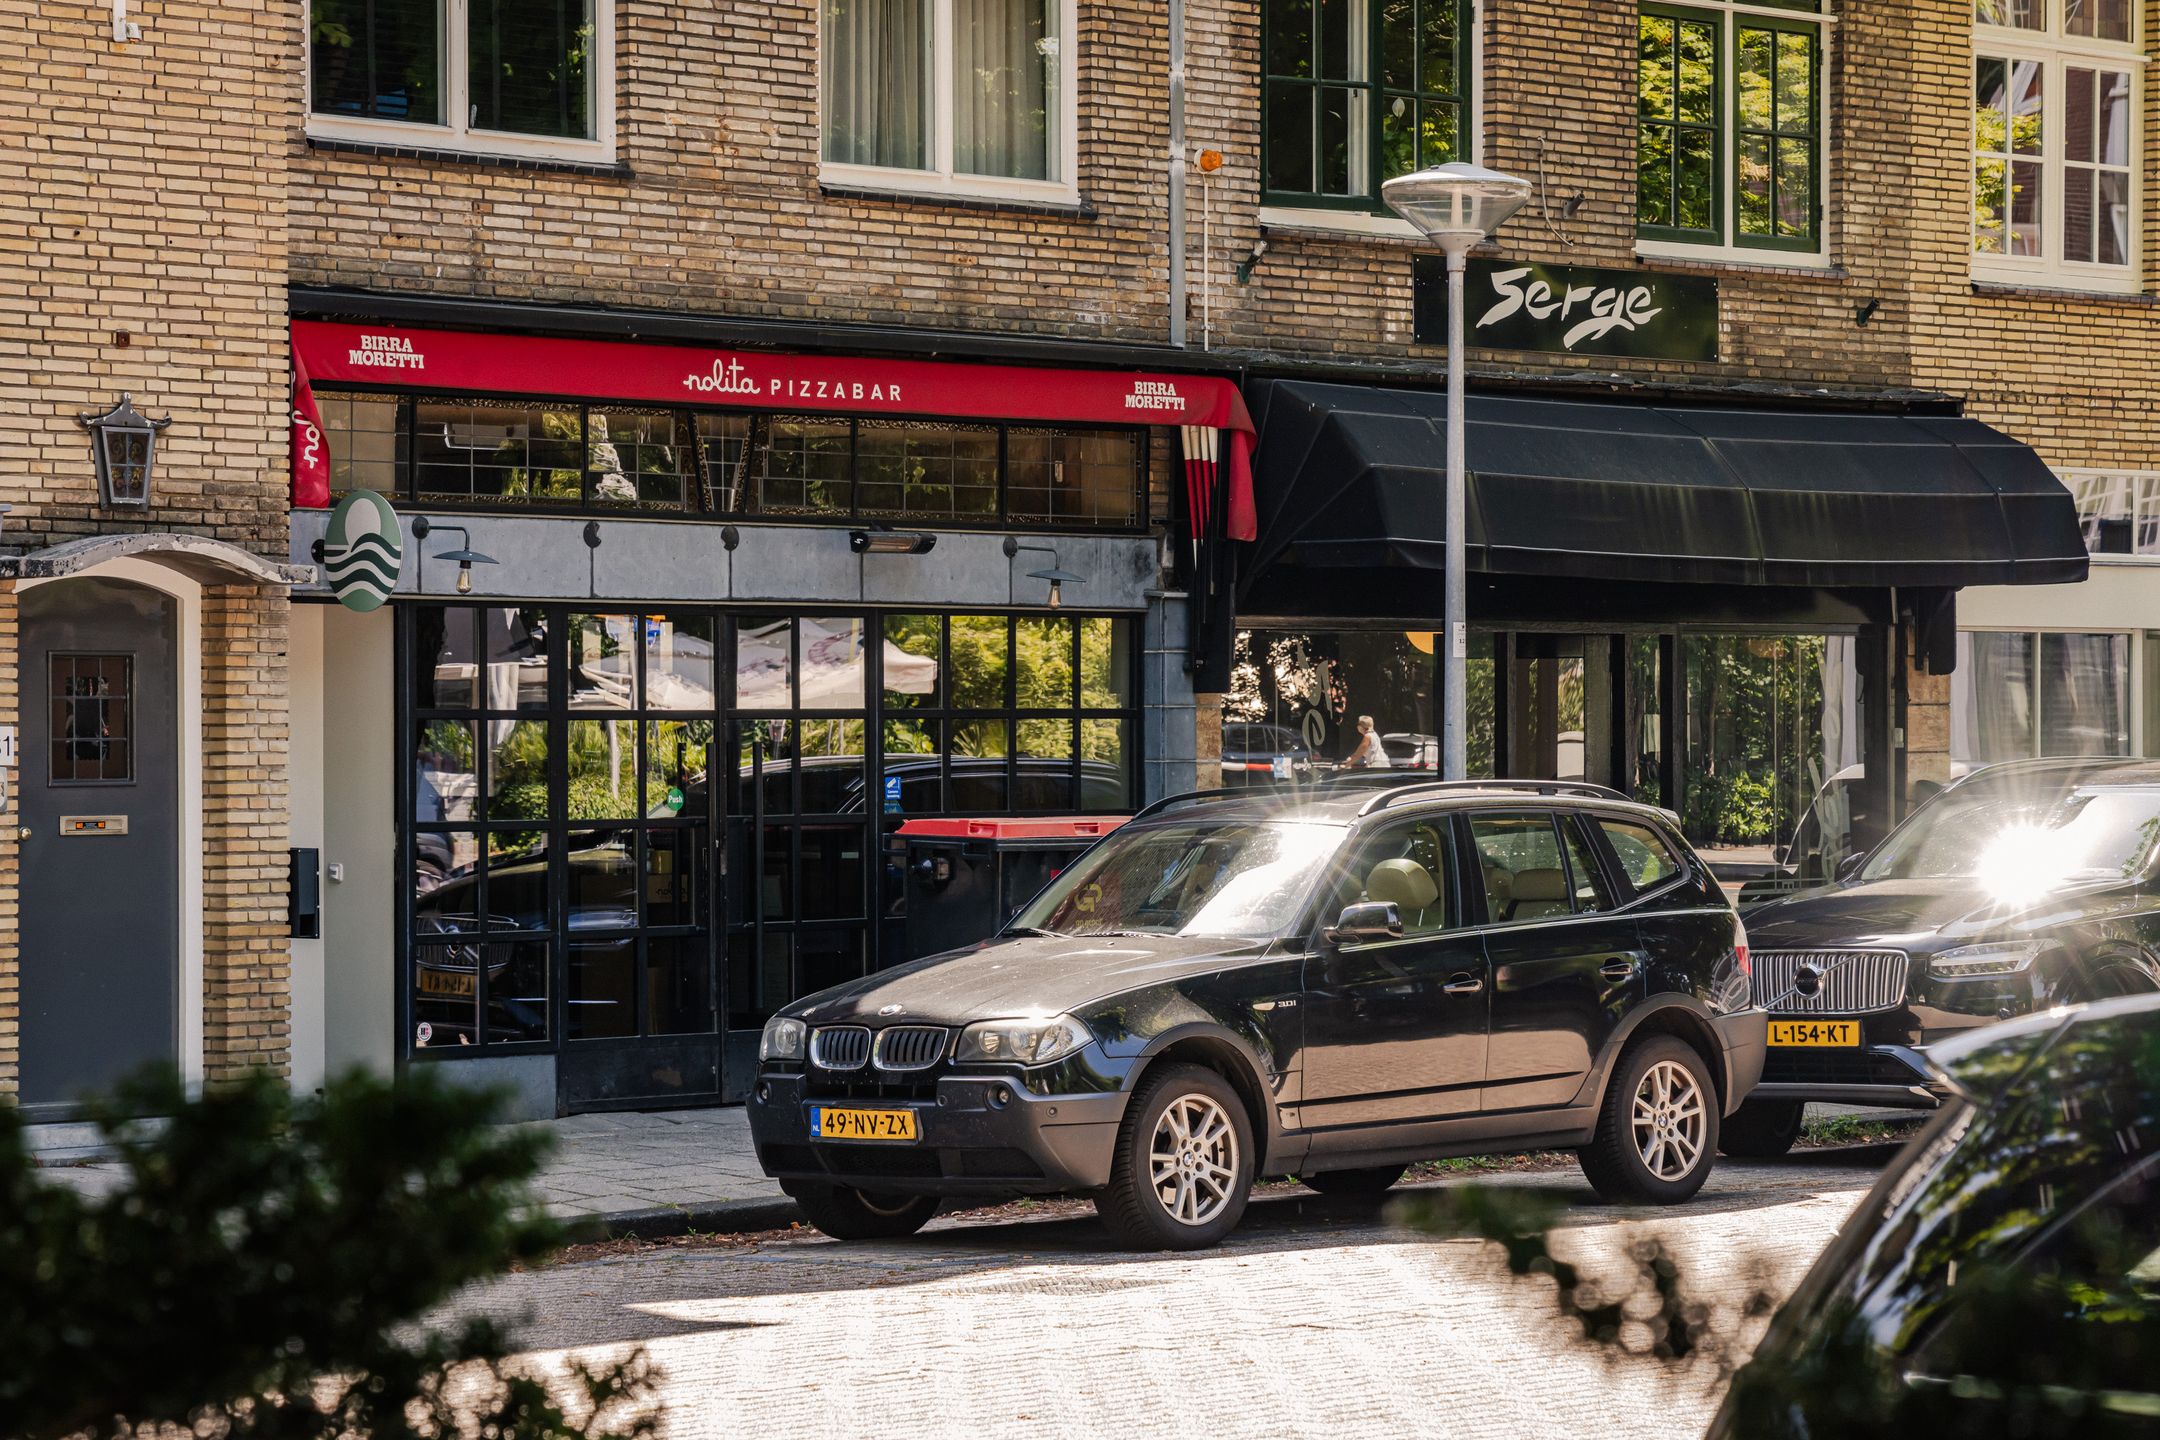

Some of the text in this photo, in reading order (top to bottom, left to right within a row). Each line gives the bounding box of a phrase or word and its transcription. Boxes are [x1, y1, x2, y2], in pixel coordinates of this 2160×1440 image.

[1476, 268, 1662, 348] Serge
[361, 335, 413, 352] BIRRA
[349, 350, 424, 368] MORETTI
[683, 357, 901, 401] nolita PIZZABAR
[1135, 381, 1176, 396] BIRRA
[1125, 395, 1185, 410] MORETTI
[0, 736, 9, 756] 1
[668, 795, 683, 803] Push
[1774, 1025, 1849, 1042] L-154-KT
